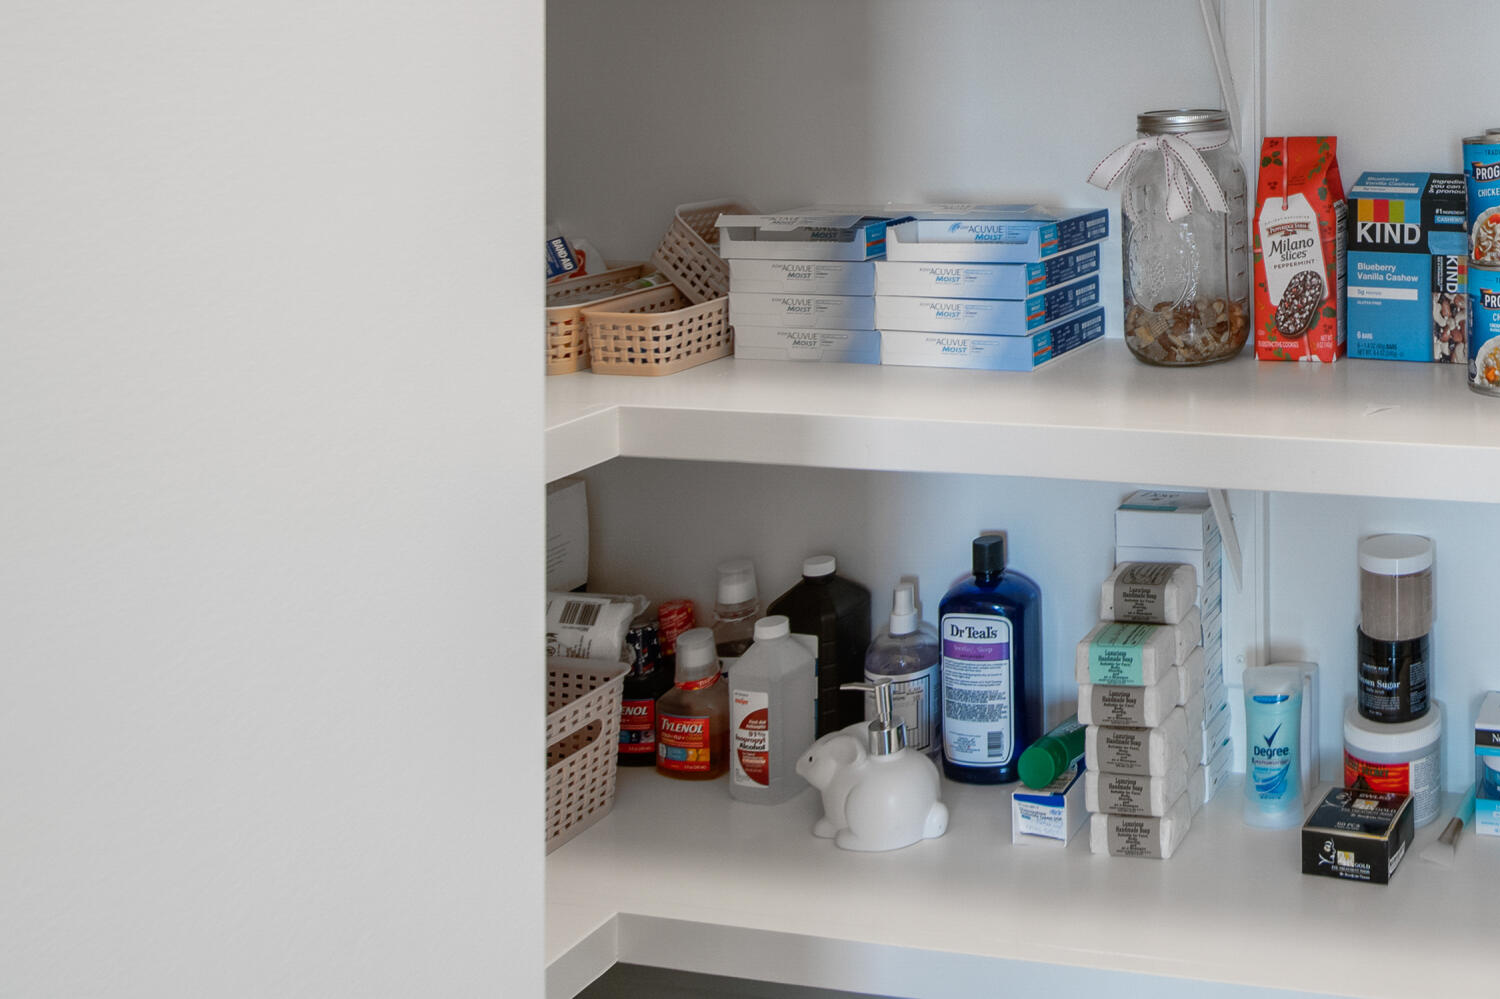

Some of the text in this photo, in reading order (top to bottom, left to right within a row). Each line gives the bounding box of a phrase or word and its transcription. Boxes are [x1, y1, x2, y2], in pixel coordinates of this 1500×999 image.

[968, 225, 1004, 234] ACUVUE
[1357, 222, 1421, 245] KIND
[1268, 238, 1314, 257] Milano
[1280, 250, 1307, 262] slices
[782, 264, 812, 272] ACUVUE
[1274, 259, 1314, 270] PEPPERMINT
[1357, 262, 1396, 272] Blueberry
[928, 268, 961, 276] ACUVUE
[1358, 272, 1419, 282] Vanilla Cashew
[1446, 256, 1458, 293] KIND
[781, 298, 812, 306] ACUVUE
[951, 624, 998, 639] Dr Teal's
[1377, 680, 1400, 690] Sugar
[661, 718, 704, 734] TYLENOL
[735, 734, 766, 744] Isopropyl
[740, 742, 766, 750] Alcohol
[1254, 746, 1289, 759] Degree
